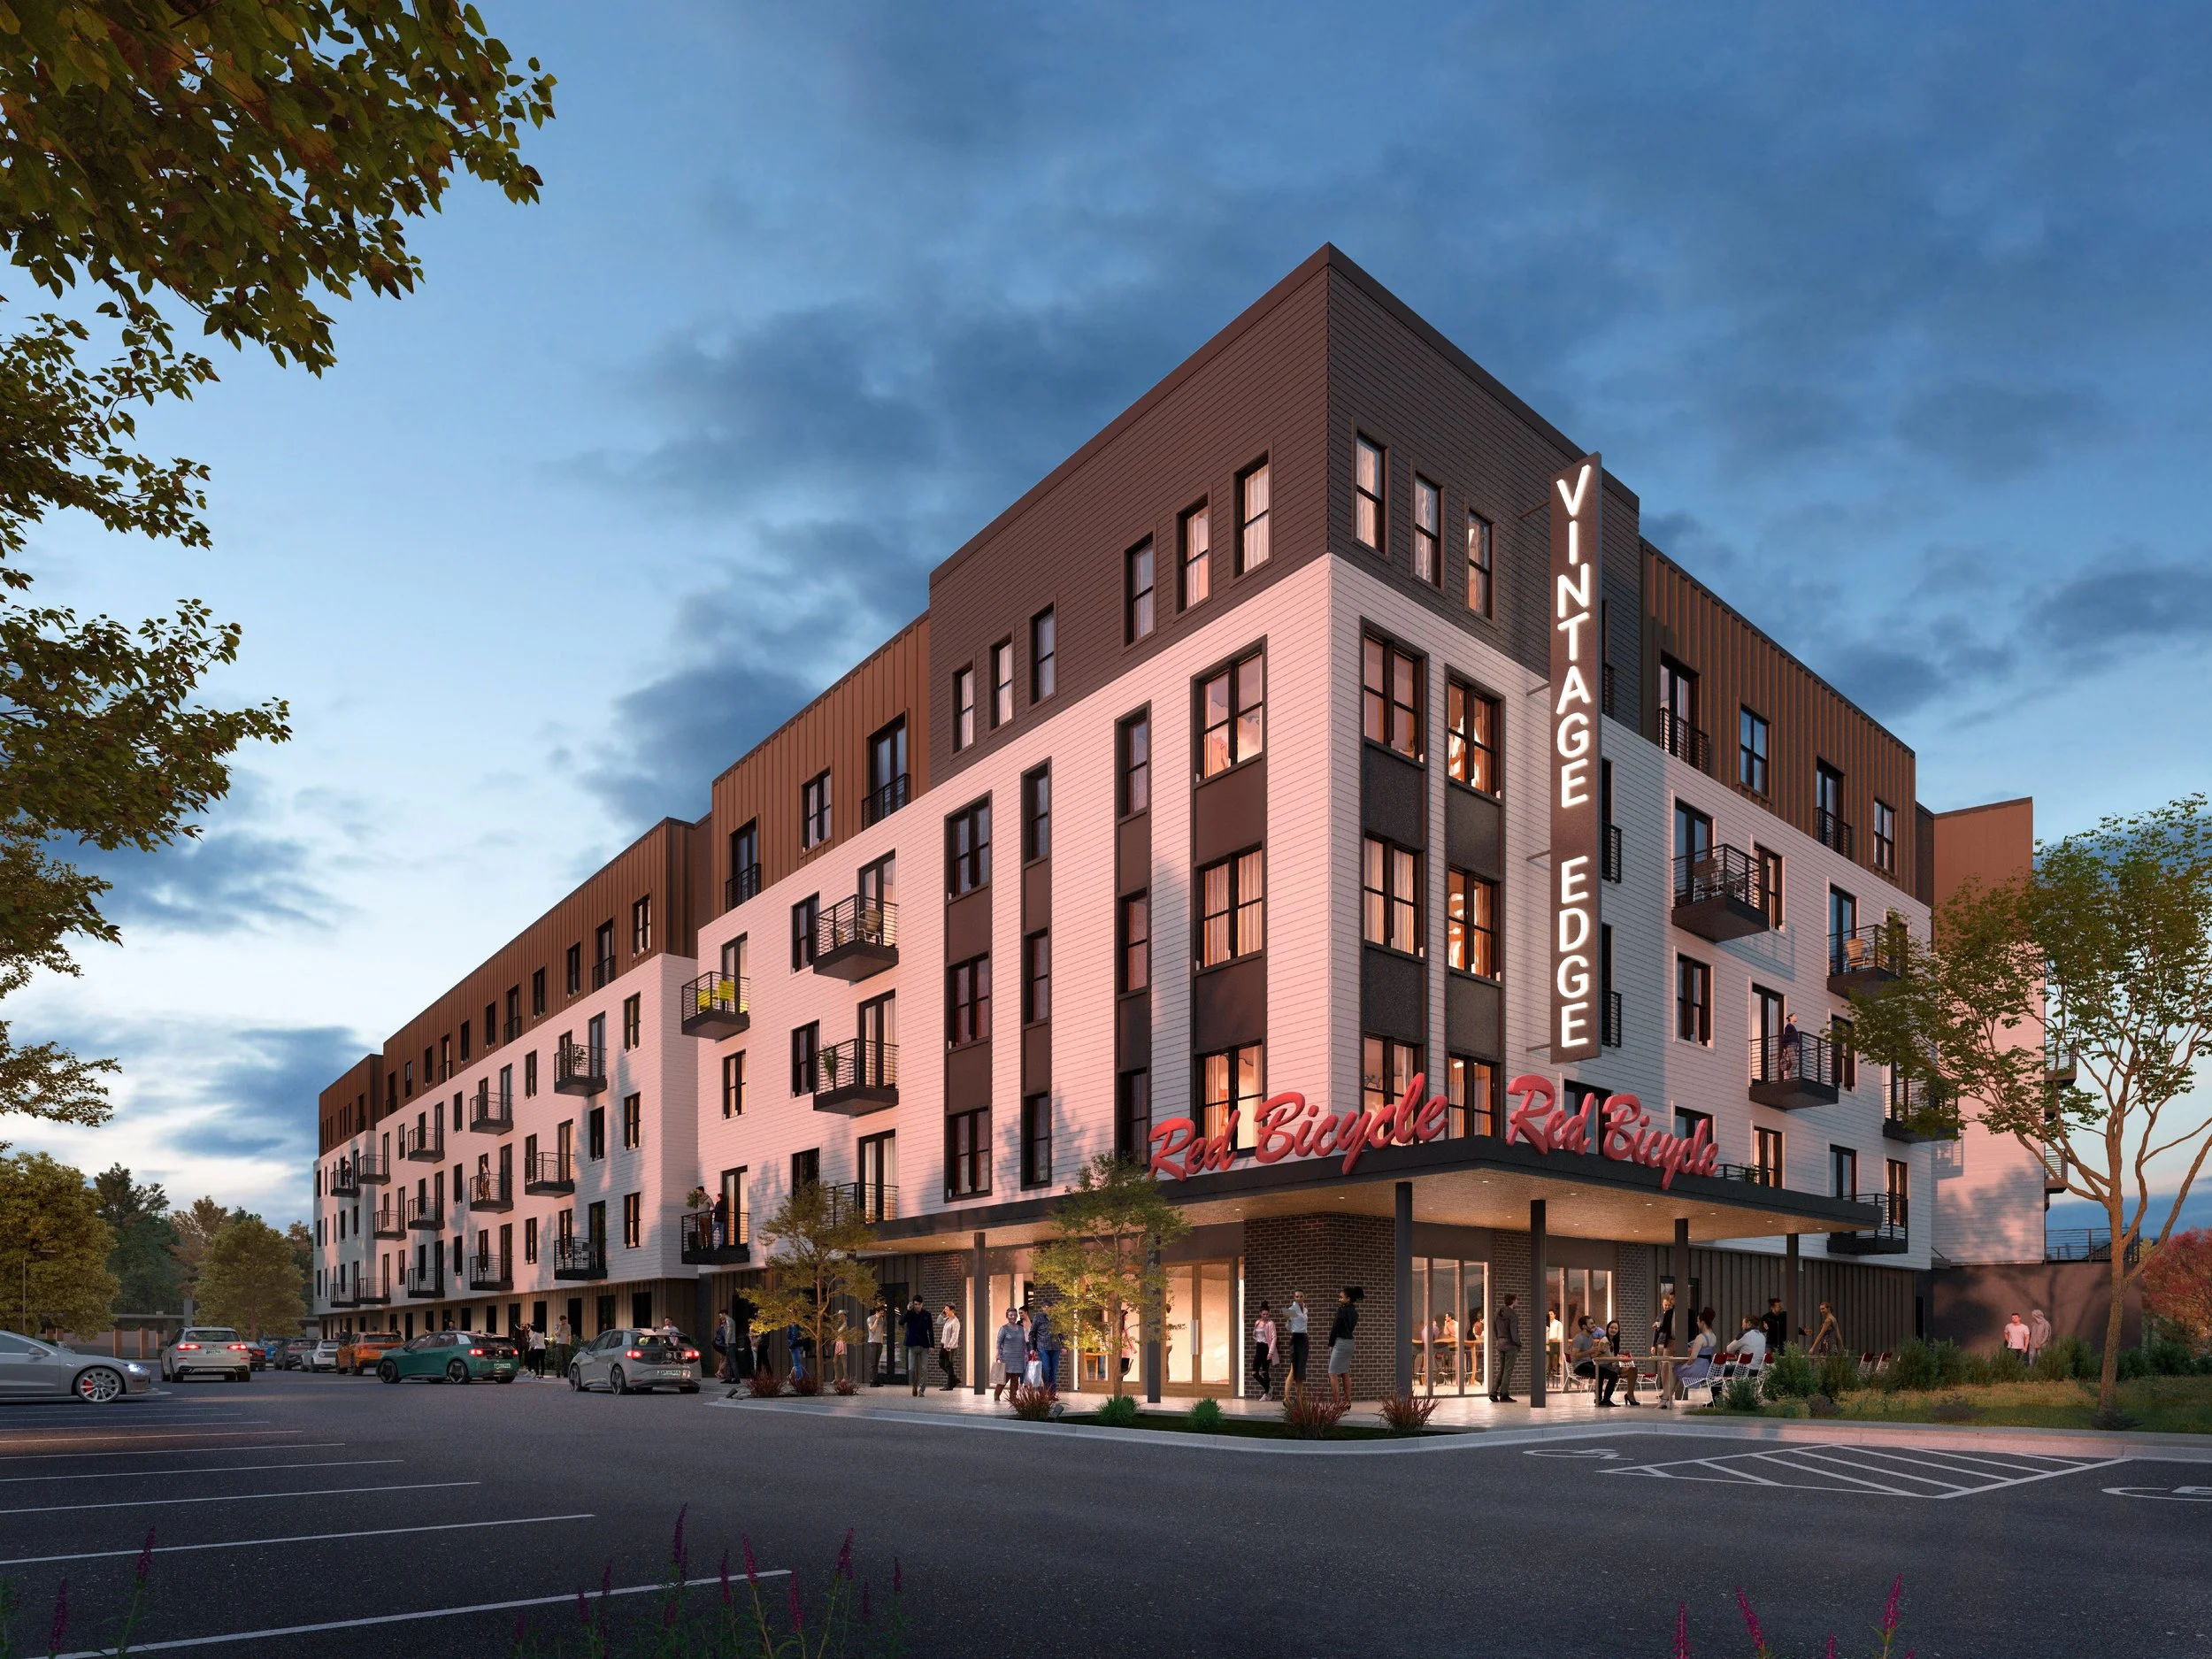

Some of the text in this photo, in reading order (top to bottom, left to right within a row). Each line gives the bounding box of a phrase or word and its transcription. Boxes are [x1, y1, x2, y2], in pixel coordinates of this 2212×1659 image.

[1555, 465, 1592, 1049] VINTAGE EDGE
[1148, 1071, 1449, 1183] Red Bicycle
[1507, 1074, 1720, 1190] Red Bicycle
